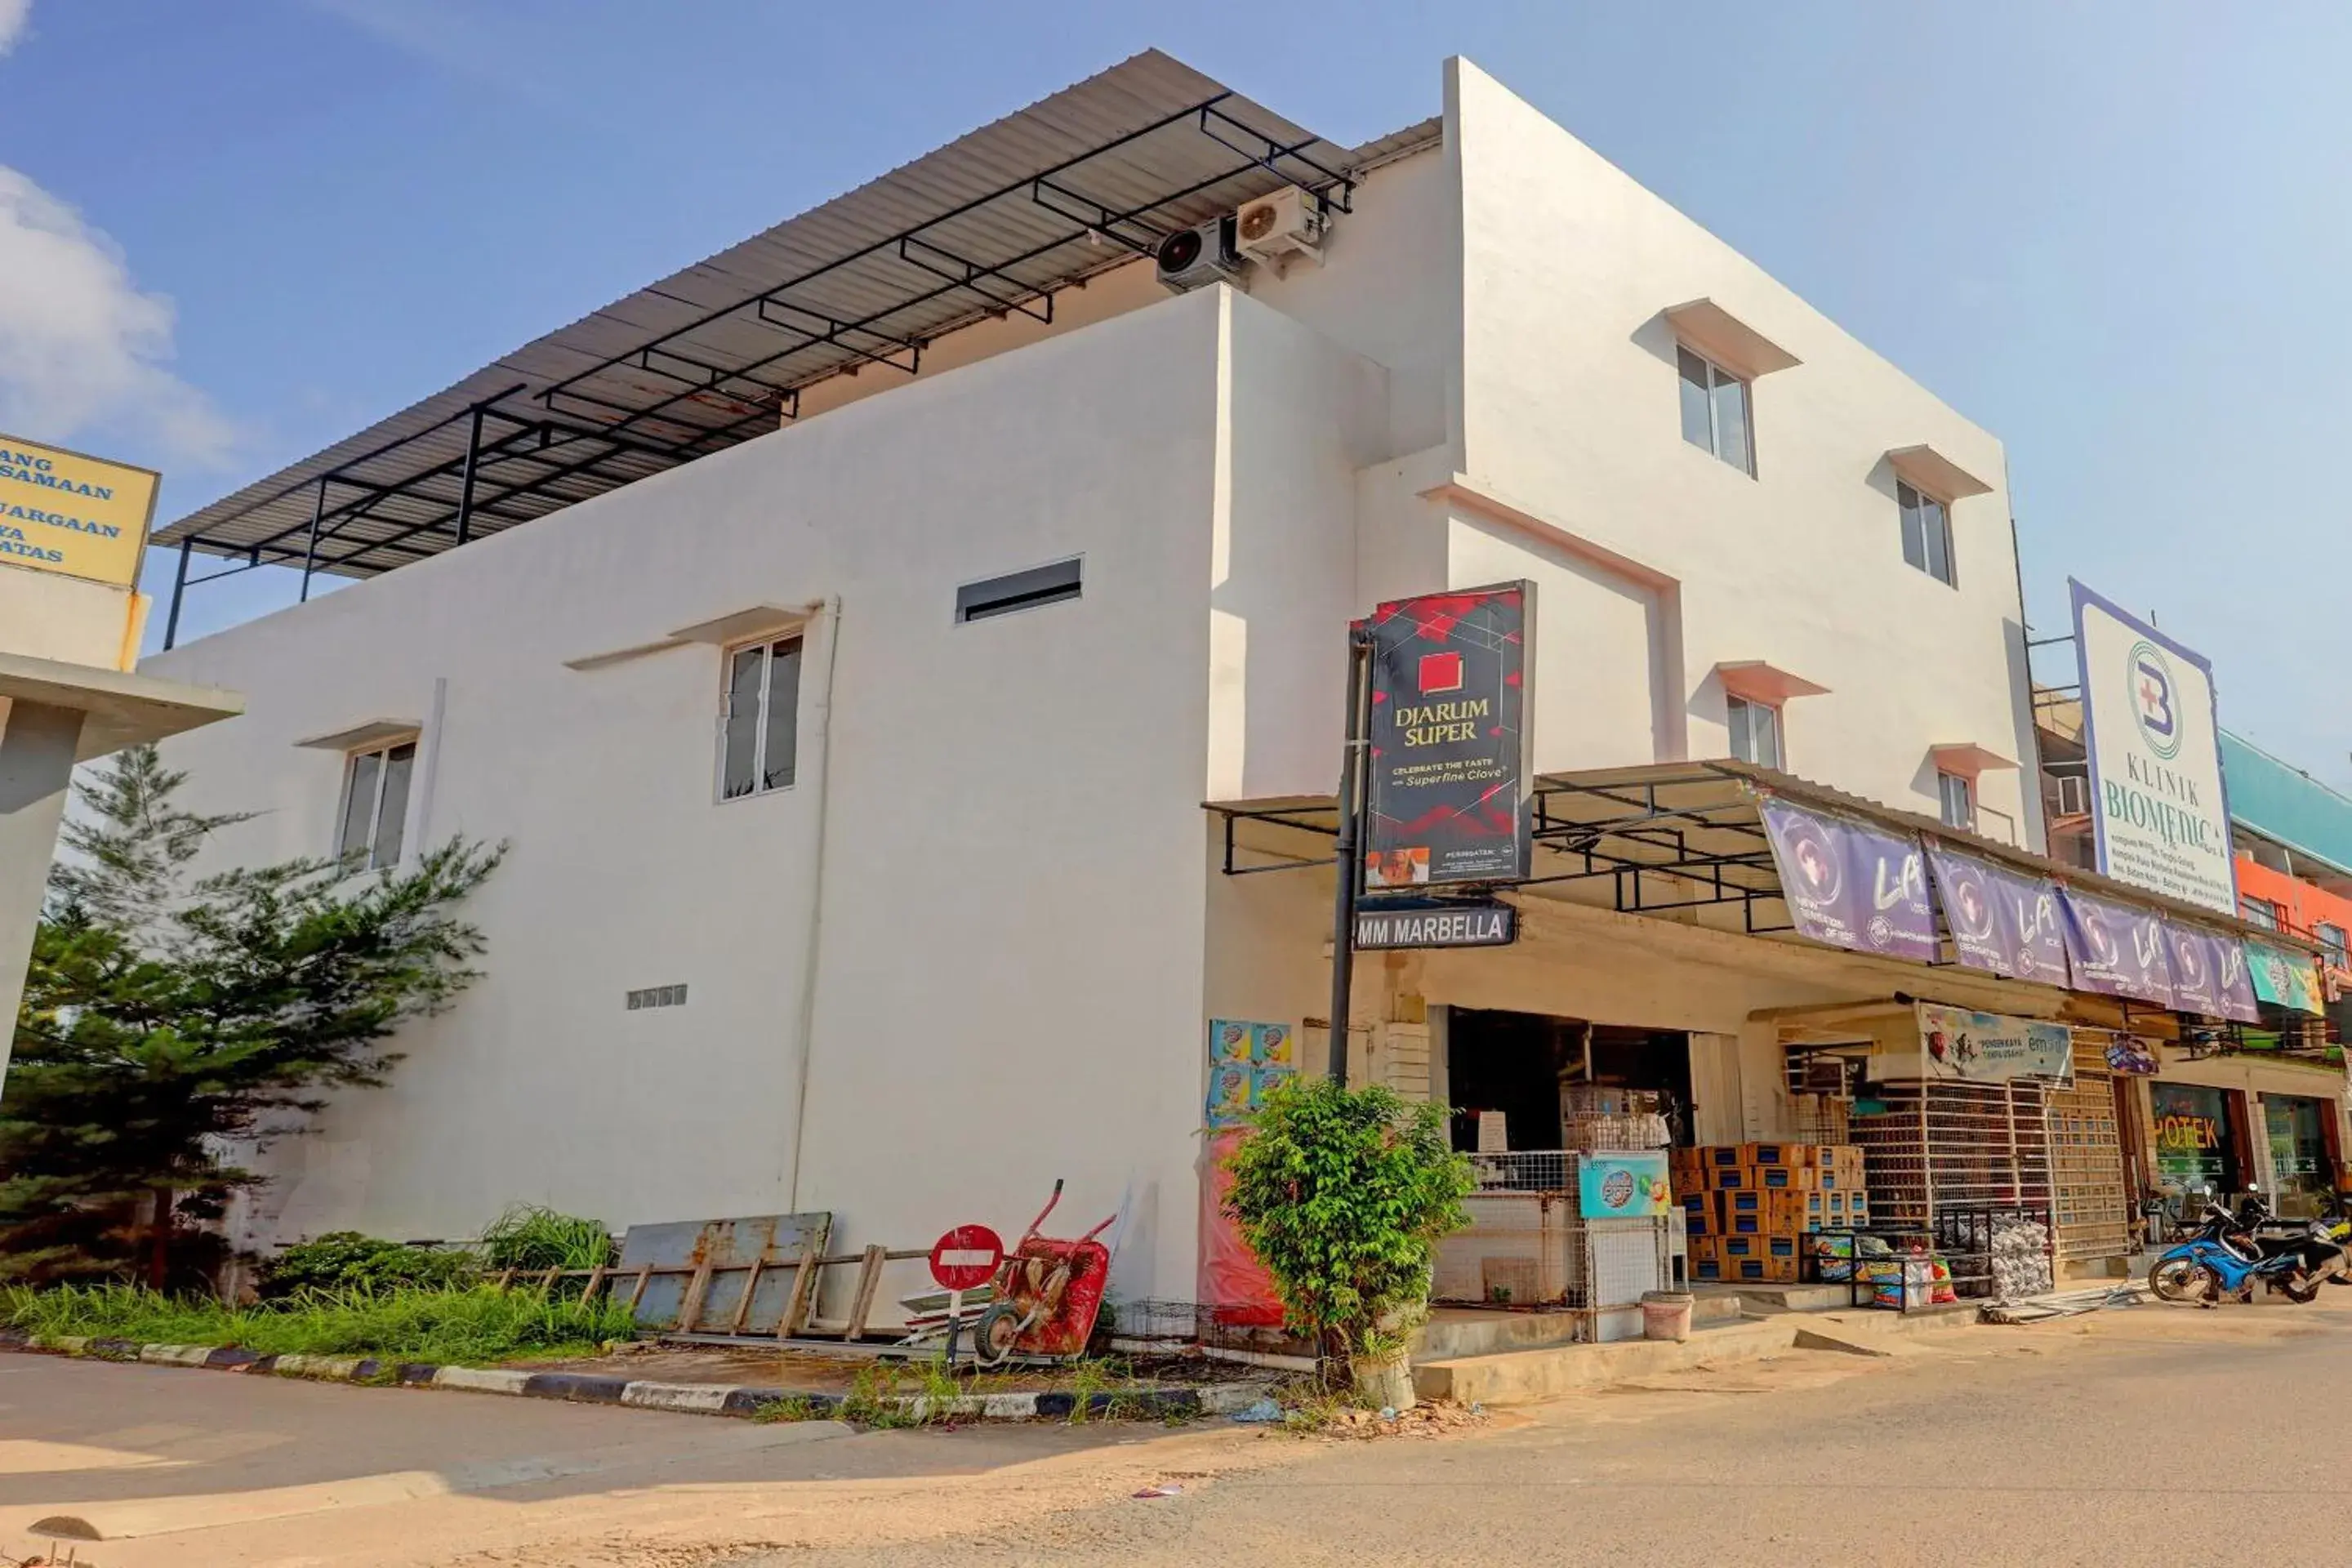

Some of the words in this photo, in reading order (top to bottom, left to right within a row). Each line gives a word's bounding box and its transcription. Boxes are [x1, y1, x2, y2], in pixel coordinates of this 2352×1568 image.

[1395, 698, 1489, 727] DJARUM
[1405, 721, 1477, 746] SUPER
[1392, 763, 1444, 775] CELEBRATE
[1445, 761, 1463, 769] THE
[1405, 772, 1465, 786] Superfine
[1468, 769, 1502, 781] Clove
[2127, 752, 2199, 807] KLINIK
[1357, 919, 1388, 945] MM
[1394, 914, 1503, 943] MARBELLA
